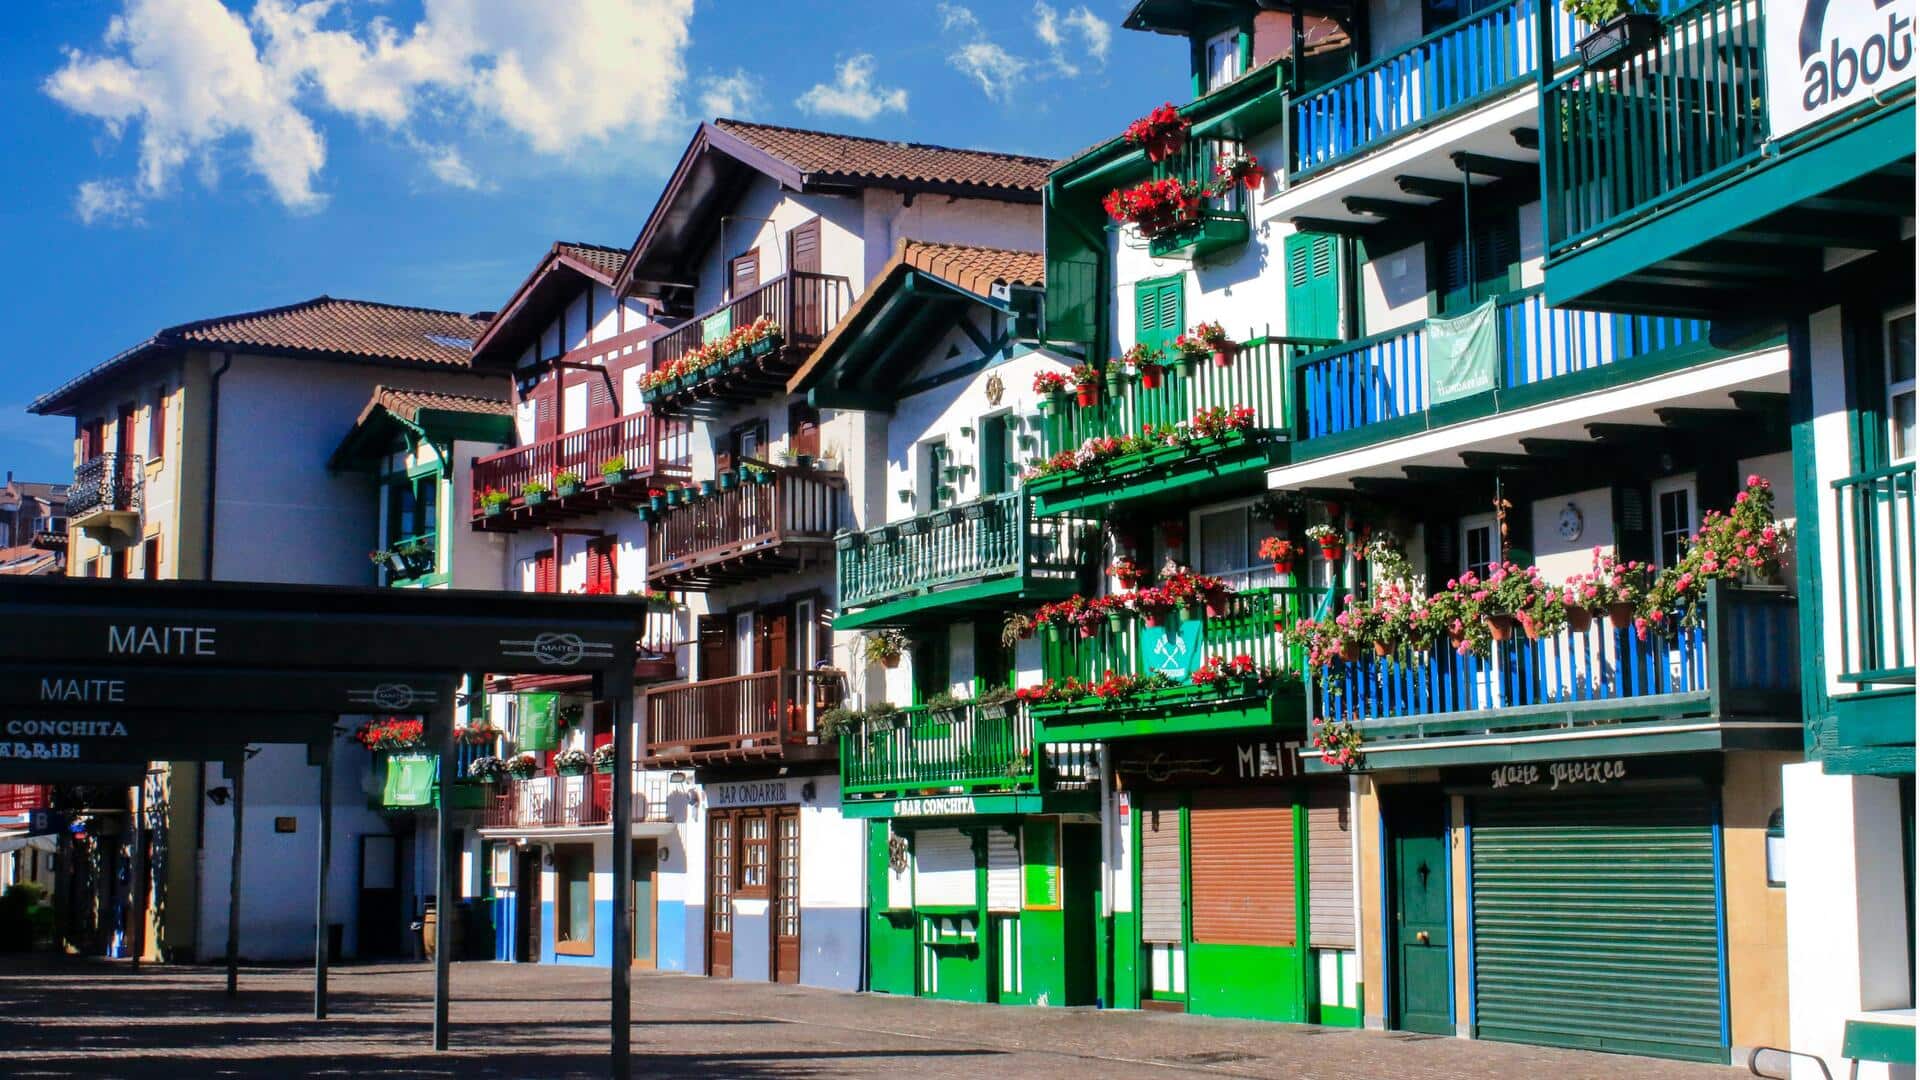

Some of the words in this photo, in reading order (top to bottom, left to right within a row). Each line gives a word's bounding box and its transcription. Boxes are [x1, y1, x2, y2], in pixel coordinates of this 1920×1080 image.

[1802, 12, 1916, 112] abot
[108, 625, 216, 655] MAITE
[41, 679, 125, 702] MAITE
[7, 720, 128, 736] CONCHITA
[1491, 765, 1539, 788] Maite
[719, 785, 737, 804] BAR
[738, 782, 787, 802] ONDARRIBI
[901, 801, 921, 816] BAR
[923, 797, 976, 816] CONCHITA
